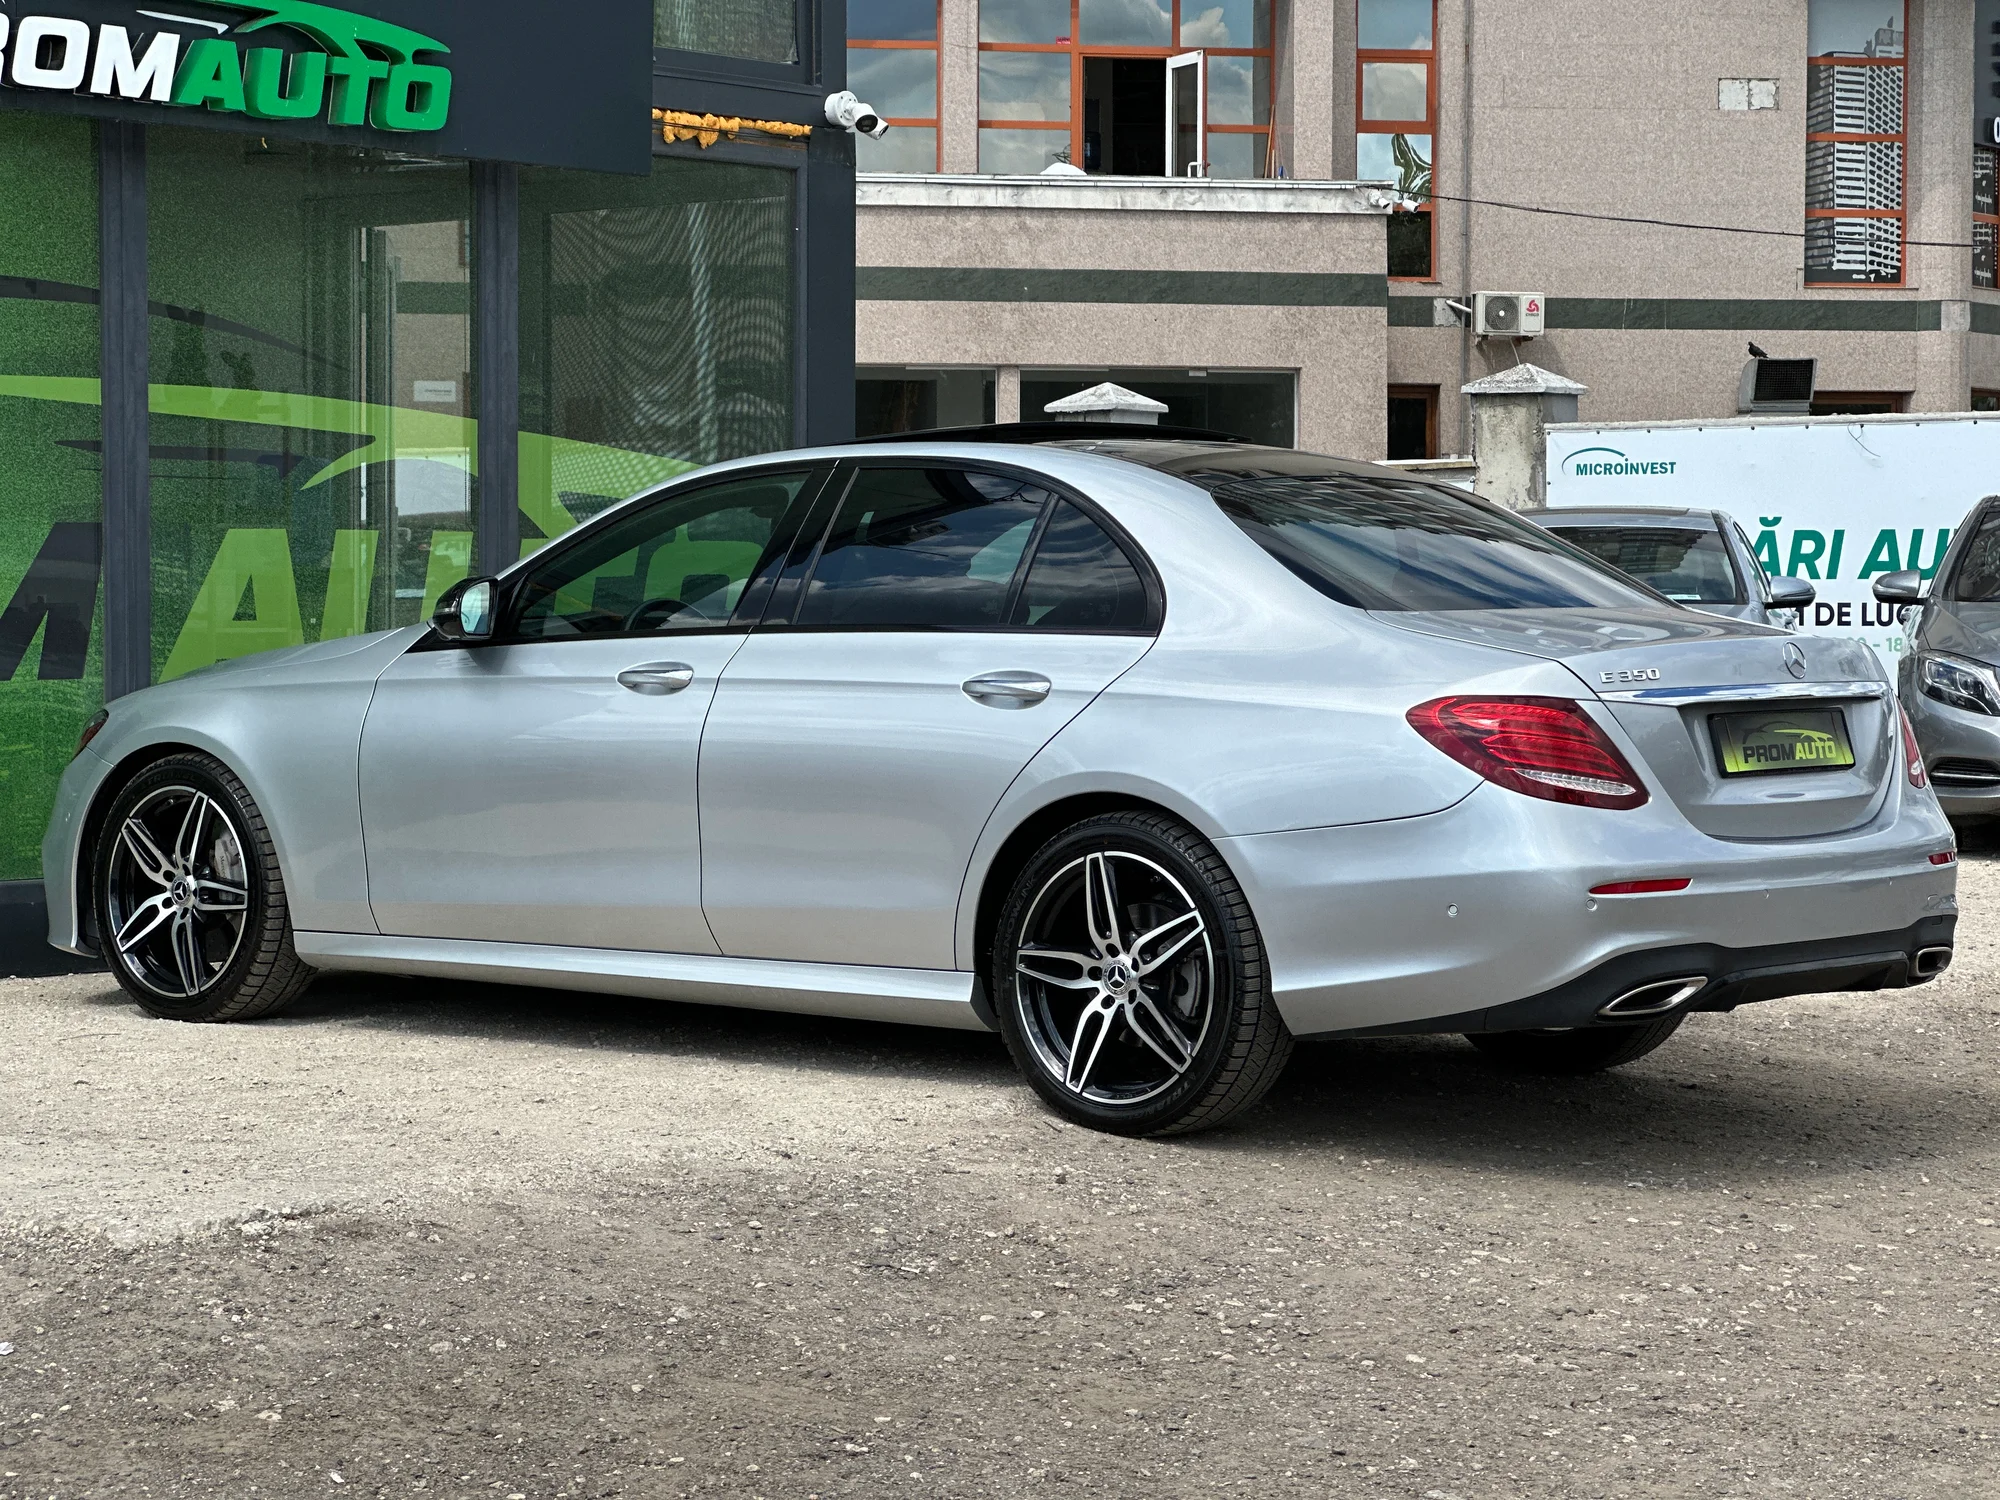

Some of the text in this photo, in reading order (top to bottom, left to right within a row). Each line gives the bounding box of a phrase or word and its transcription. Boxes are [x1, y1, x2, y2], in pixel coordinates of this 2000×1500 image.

[0, 12, 452, 131] OMAUTO
[1857, 528, 1957, 580] AU
[1815, 602, 1852, 626] DE
[1599, 668, 1660, 683] E 350
[1742, 741, 1837, 764] PROMAUTO
